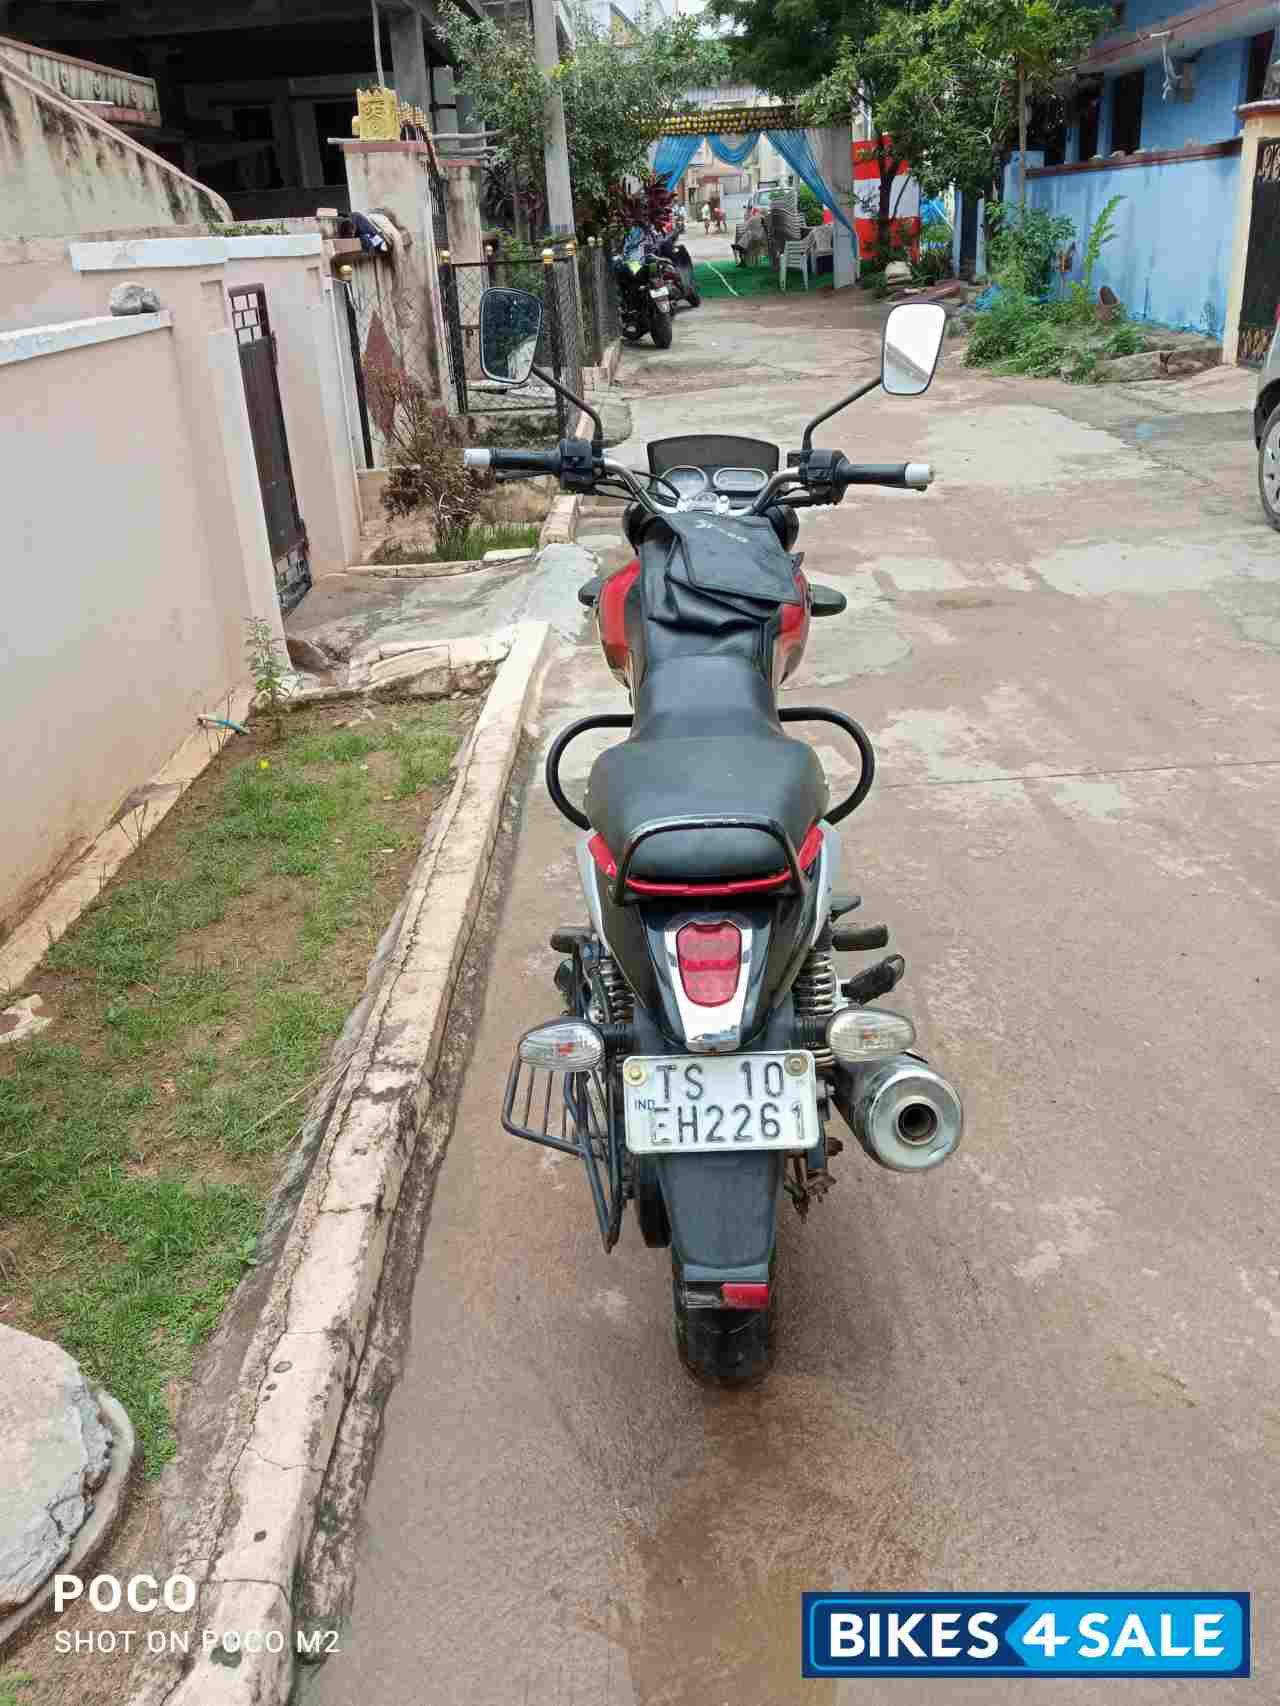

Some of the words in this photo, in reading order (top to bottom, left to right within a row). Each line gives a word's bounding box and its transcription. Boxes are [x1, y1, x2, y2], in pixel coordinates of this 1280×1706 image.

[656, 1062, 704, 1102] TS
[740, 1060, 784, 1098] 10
[634, 1098, 655, 1111] IND
